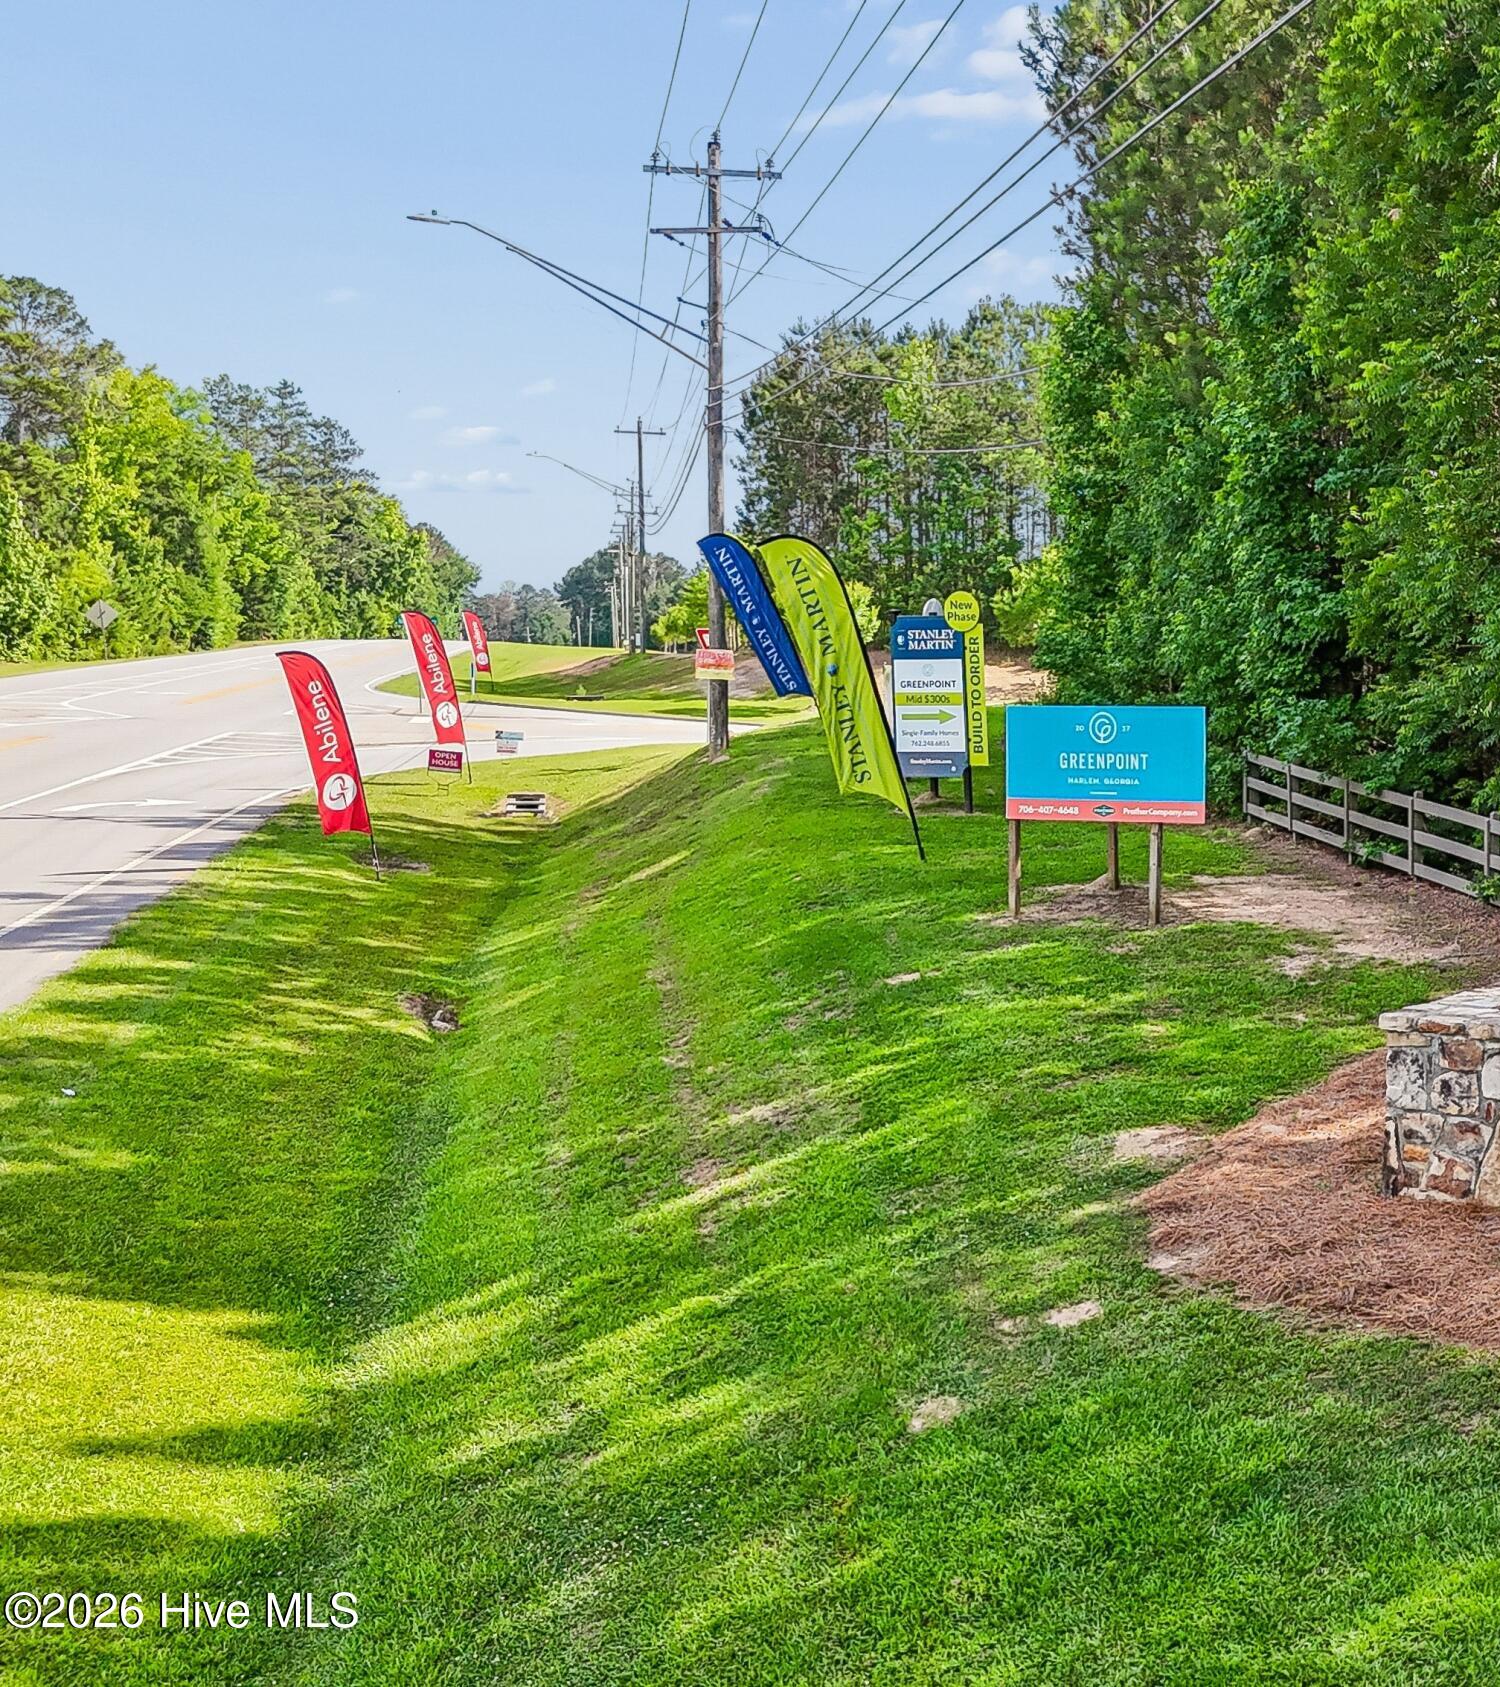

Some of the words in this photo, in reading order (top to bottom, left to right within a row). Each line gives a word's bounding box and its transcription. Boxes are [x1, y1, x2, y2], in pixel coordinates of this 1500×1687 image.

[716, 547, 756, 614] MARTIN
[786, 556, 837, 657] MARTIN
[949, 600, 973, 610] New
[947, 611, 977, 622] Phase
[907, 629, 955, 640] STANLEY
[907, 640, 954, 650] MARTIN
[421, 632, 448, 694] Abilene
[755, 629, 797, 691] STANLEY
[968, 636, 981, 686] ORDER
[900, 680, 957, 689] GREENPOINT
[905, 695, 923, 704] Mid
[924, 694, 951, 704] $300s
[970, 689, 982, 709] TO
[308, 679, 342, 764] Abilene
[1075, 724, 1085, 732] 20
[831, 685, 872, 784] STANLEY
[972, 711, 984, 754] BUILD
[431, 758, 459, 767] HOUSE
[434, 751, 457, 760] OPEN
[1060, 752, 1149, 770] GREENPOINT
[1103, 777, 1140, 785] GEORGIA
